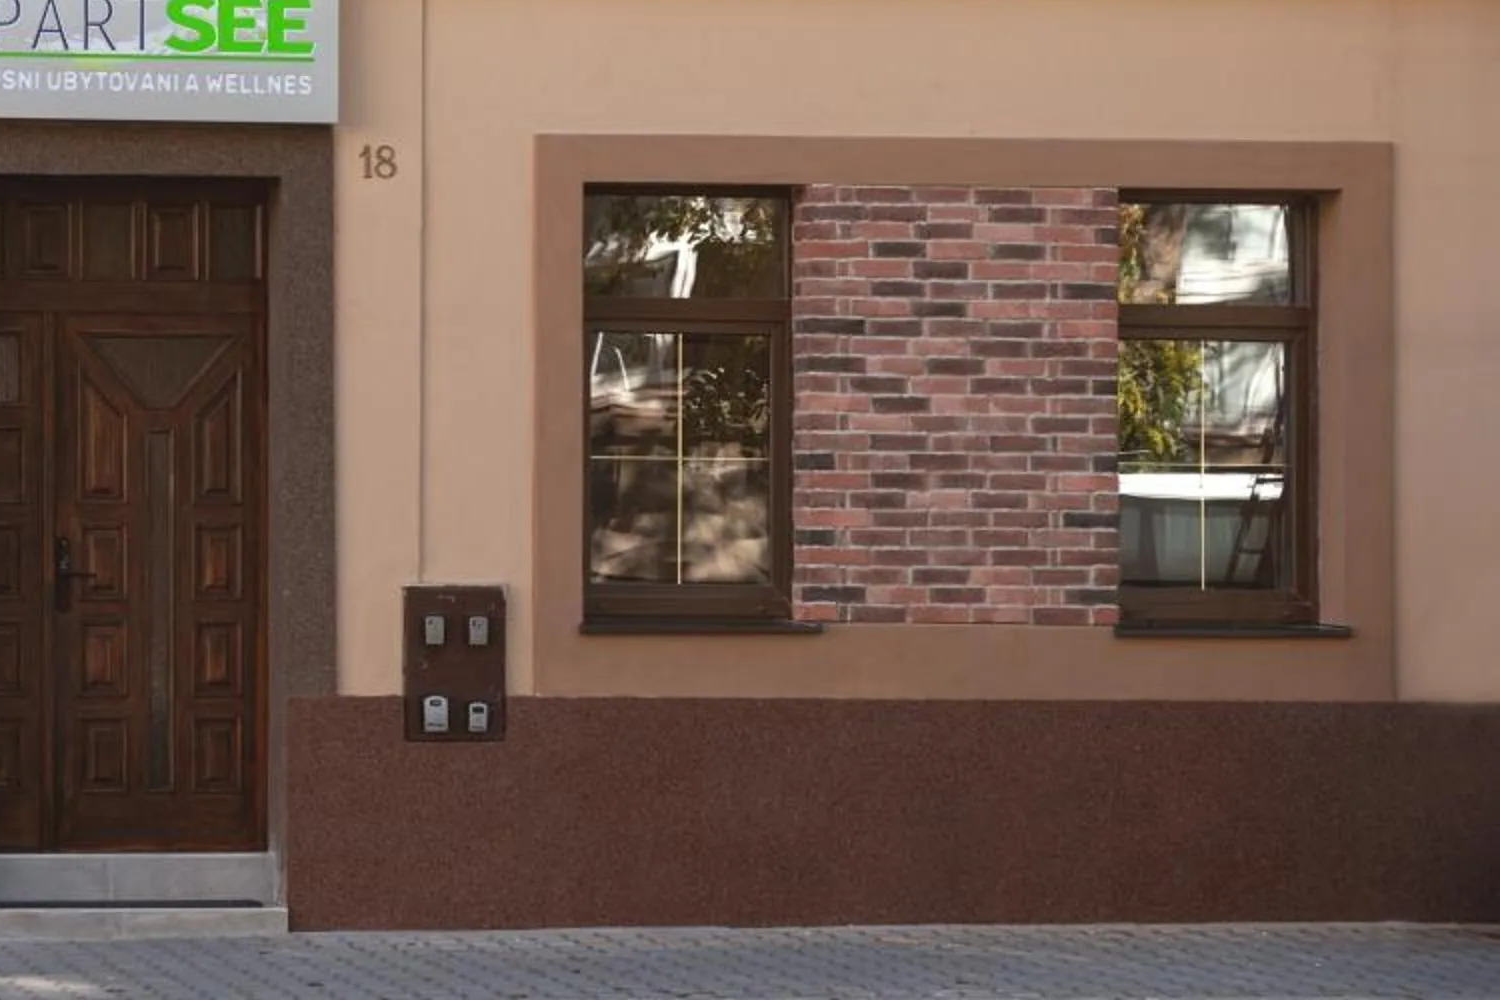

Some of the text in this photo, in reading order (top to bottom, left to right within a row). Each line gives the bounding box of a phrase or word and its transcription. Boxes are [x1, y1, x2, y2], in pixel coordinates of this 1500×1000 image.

[47, 70, 179, 93] UBYTOVANI
[184, 72, 200, 93] A
[206, 72, 314, 95] WELLNES
[358, 143, 398, 179] 18
